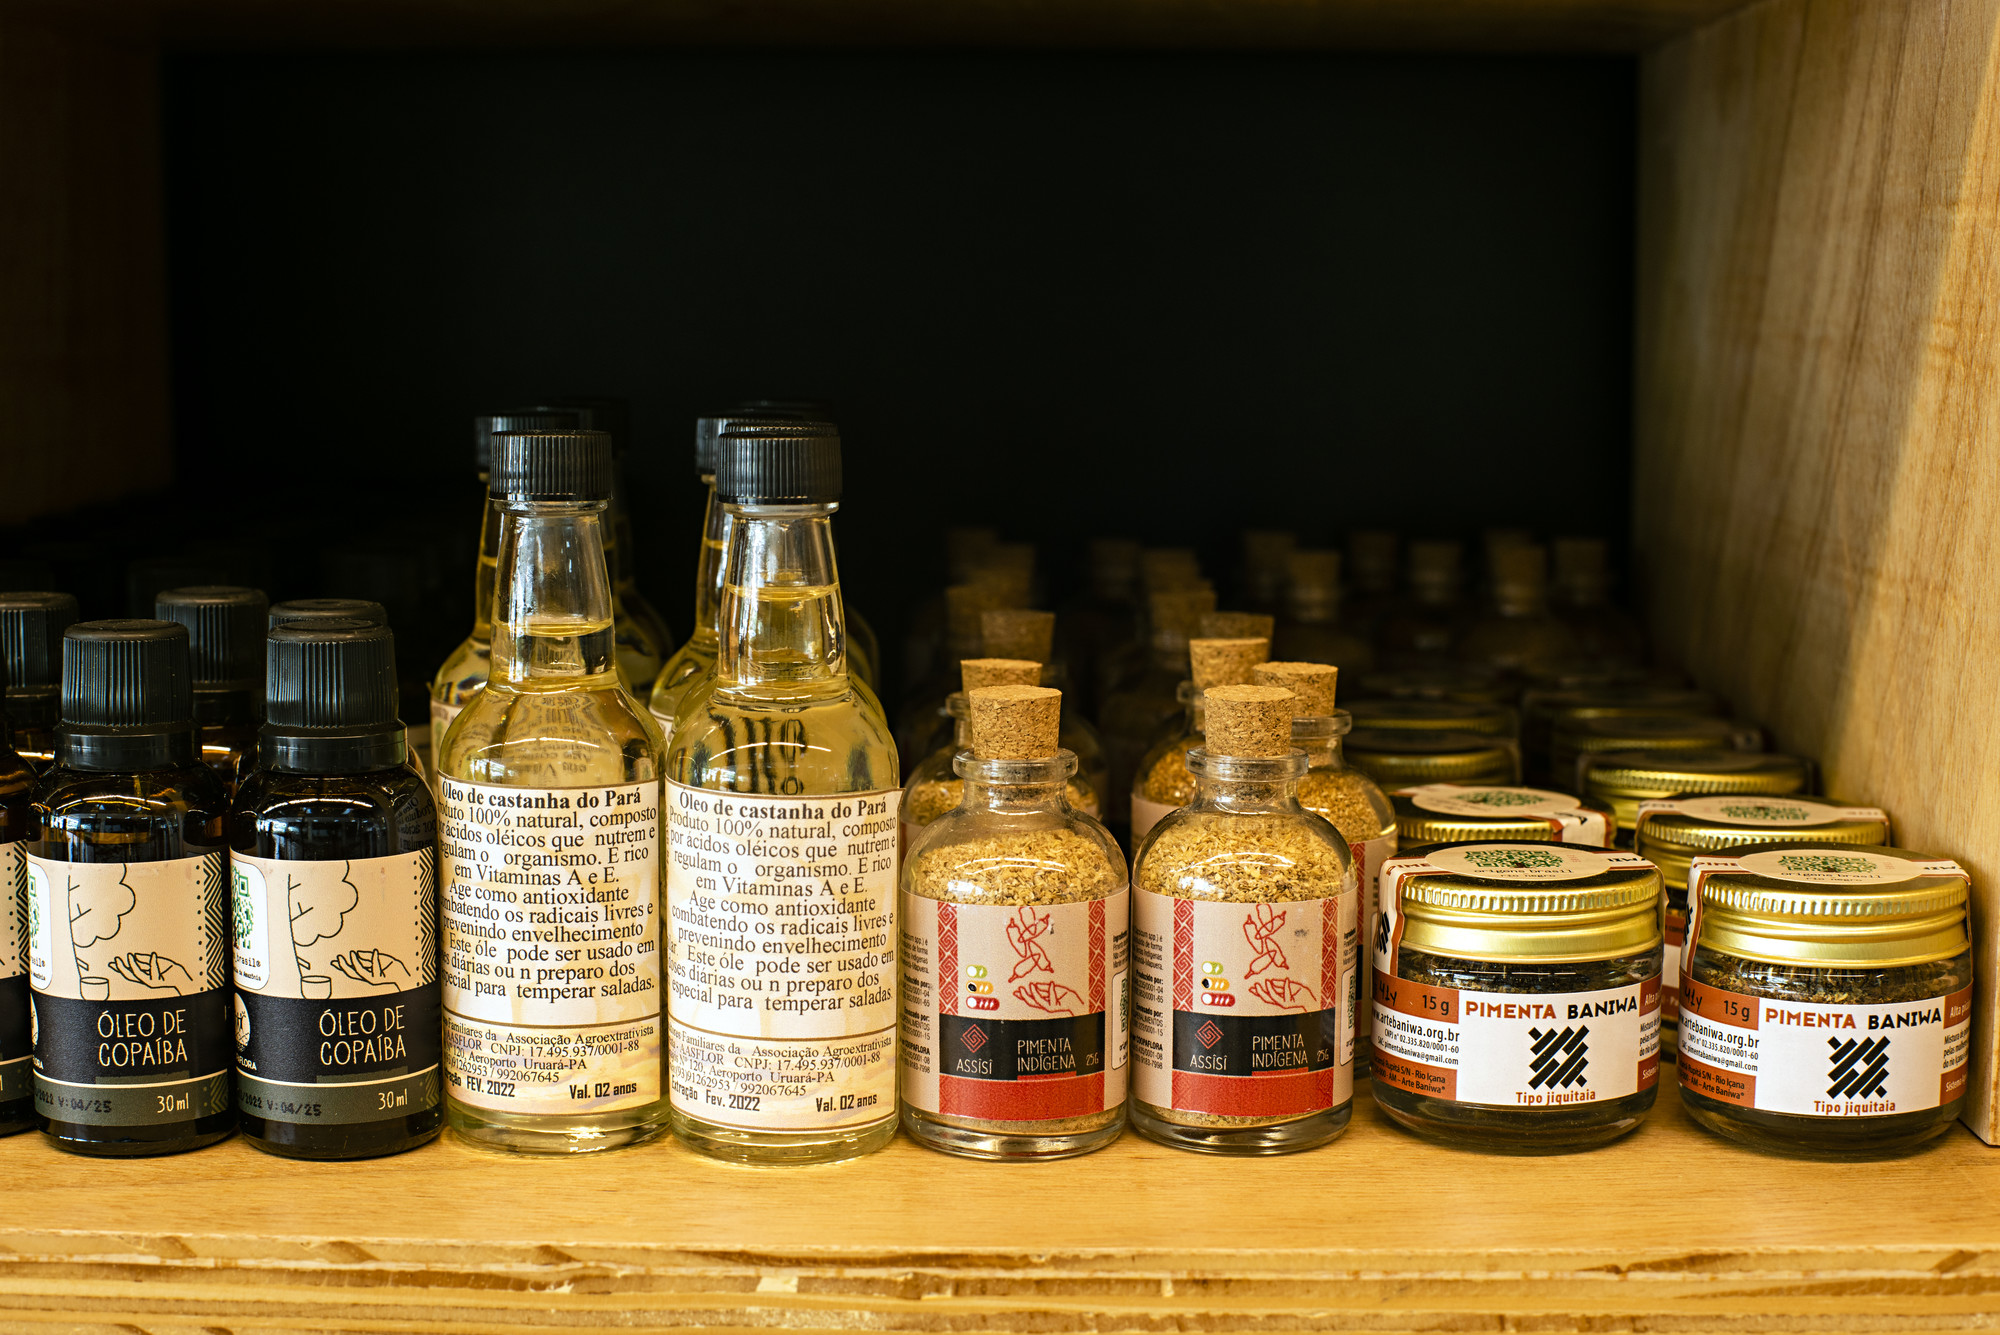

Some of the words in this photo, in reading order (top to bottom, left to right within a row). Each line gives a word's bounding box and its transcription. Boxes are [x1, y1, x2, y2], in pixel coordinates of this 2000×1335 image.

[442, 778, 463, 799] Óleo
[489, 793, 570, 808] castanha
[605, 787, 641, 807] Pará
[680, 789, 708, 812] Óleo
[714, 799, 733, 816] de
[739, 803, 824, 819] castanha
[831, 802, 850, 818] do
[858, 797, 886, 816] Pará
[469, 807, 510, 826] 100%
[516, 812, 584, 830] natural,
[589, 806, 657, 829] composto
[669, 806, 709, 832] Produto
[715, 818, 763, 838] 100%
[769, 821, 836, 841] natural,
[842, 817, 896, 839] composto
[446, 820, 481, 842] ácidos
[487, 828, 545, 847] oléicos
[552, 834, 584, 852] que
[595, 829, 646, 847] nutrem
[671, 828, 683, 844] por
[687, 831, 730, 854] ácidos
[736, 840, 799, 858] oléicos
[805, 844, 837, 862] que
[504, 852, 601, 870] organismo.
[624, 845, 648, 862] rico
[674, 849, 721, 873] regulam
[755, 862, 851, 882] organismo.
[872, 854, 891, 872] rico
[477, 864, 560, 885] Vitaminas
[450, 879, 471, 900] Age
[475, 887, 517, 903] como
[523, 887, 629, 904] antioxidante
[696, 877, 716, 890] em
[722, 876, 813, 897] Vitaminas
[529, 907, 598, 923] radicais
[604, 904, 643, 921] livres
[689, 890, 715, 912] Age
[721, 899, 768, 915] como
[775, 897, 875, 916] antioxidante
[444, 915, 506, 940] prevenindo
[512, 924, 643, 942] envelhecimento
[672, 905, 748, 933] combatendo
[755, 922, 774, 935] os
[780, 918, 848, 935] radicais
[853, 913, 887, 932] livres
[450, 934, 471, 953] Este
[475, 942, 497, 957] óle
[507, 946, 549, 964] pode
[555, 948, 581, 961] ser
[587, 941, 633, 960] usado
[678, 926, 756, 953] prevenindo
[762, 932, 887, 954] envelhecimento
[452, 956, 490, 975] diárias
[537, 966, 603, 984] preparo
[609, 961, 635, 977] dos
[687, 945, 716, 966] Este
[756, 957, 800, 975] pode
[806, 959, 832, 973] ser
[837, 953, 878, 972] usado
[881, 949, 894, 964] em
[475, 982, 506, 997] para
[517, 984, 595, 1003] temperar
[601, 977, 655, 997] saladas.
[689, 966, 735, 990] diárias
[741, 978, 762, 991] ou
[787, 977, 852, 996] preparo
[857, 971, 879, 988] dos
[672, 978, 712, 1003] especial
[718, 994, 753, 1009] para
[765, 996, 844, 1015] temperar
[849, 987, 893, 1008] saladas.
[1422, 995, 1437, 1010] 15
[1441, 1001, 1449, 1015] g
[1465, 1001, 1556, 1020] PIMENTA
[1568, 996, 1637, 1019] BANIWA
[319, 1010, 376, 1037] ÓLEO
[384, 1005, 405, 1031] DE
[1724, 1000, 1738, 1016] 15
[1742, 1007, 1750, 1021] g
[1766, 1007, 1857, 1029] PIMENTA
[1868, 1007, 1942, 1030] BANIWA
[97, 1010, 155, 1039] ÓLEO
[164, 1008, 186, 1034] DE
[320, 1035, 407, 1066] COPAÍBA
[491, 1044, 524, 1056] CNPJ:
[530, 1040, 639, 1058] 17.495.937/0001-88
[506, 1033, 571, 1052] Associação
[575, 1026, 654, 1047] Agroextrativista
[752, 1045, 819, 1060] Associação
[823, 1035, 892, 1059] Agroextrativista
[1017, 1037, 1072, 1054] PIMENTA
[1252, 1034, 1304, 1050] PIMENTA
[1400, 1035, 1459, 1053] 02.335.820/0001-60
[1701, 1039, 1758, 1060] 02.335.820/0001-60
[99, 1036, 188, 1067] COPAÍBA
[469, 1054, 516, 1070] Aeroporto
[524, 1059, 587, 1070] Uruará-PA
[680, 1044, 724, 1065] AASFLOR
[734, 1056, 771, 1070] CNPJ:
[777, 1051, 880, 1071] 17.495.937/0001-88
[1085, 1052, 1099, 1067] 25G
[1190, 1054, 1227, 1071] ASSÎSÎ
[1252, 1051, 1308, 1068] INDÍGENA
[1385, 1041, 1458, 1065] pimentabaniwa@gmail.com
[709, 1065, 762, 1082] Aeroporto
[956, 1057, 993, 1075] ASSÎSÎ
[1017, 1054, 1076, 1073] INDÍGENA
[467, 1075, 484, 1092] FEV.
[487, 1081, 515, 1097] 2022
[497, 1069, 559, 1082] 992067645
[1401, 1078, 1414, 1088] Arte
[1415, 1070, 1426, 1080] Rio
[1427, 1072, 1445, 1084] Içana
[1702, 1081, 1714, 1093] Arte
[1716, 1076, 1726, 1085] Rio
[1727, 1078, 1745, 1089] Içana
[570, 1084, 591, 1099] Val.
[613, 1083, 637, 1096] anos
[672, 1075, 698, 1100] Extração
[706, 1089, 725, 1107] Fev.
[729, 1095, 760, 1111] 2022
[740, 1082, 806, 1096] 992067645
[1516, 1092, 1543, 1106] Tipo
[1546, 1090, 1596, 1106] jiquitaia
[816, 1098, 836, 1112] Val.
[857, 1093, 877, 1107] anos
[1814, 1100, 1841, 1114] Tipo
[1844, 1100, 1896, 1115] jiquitaia
